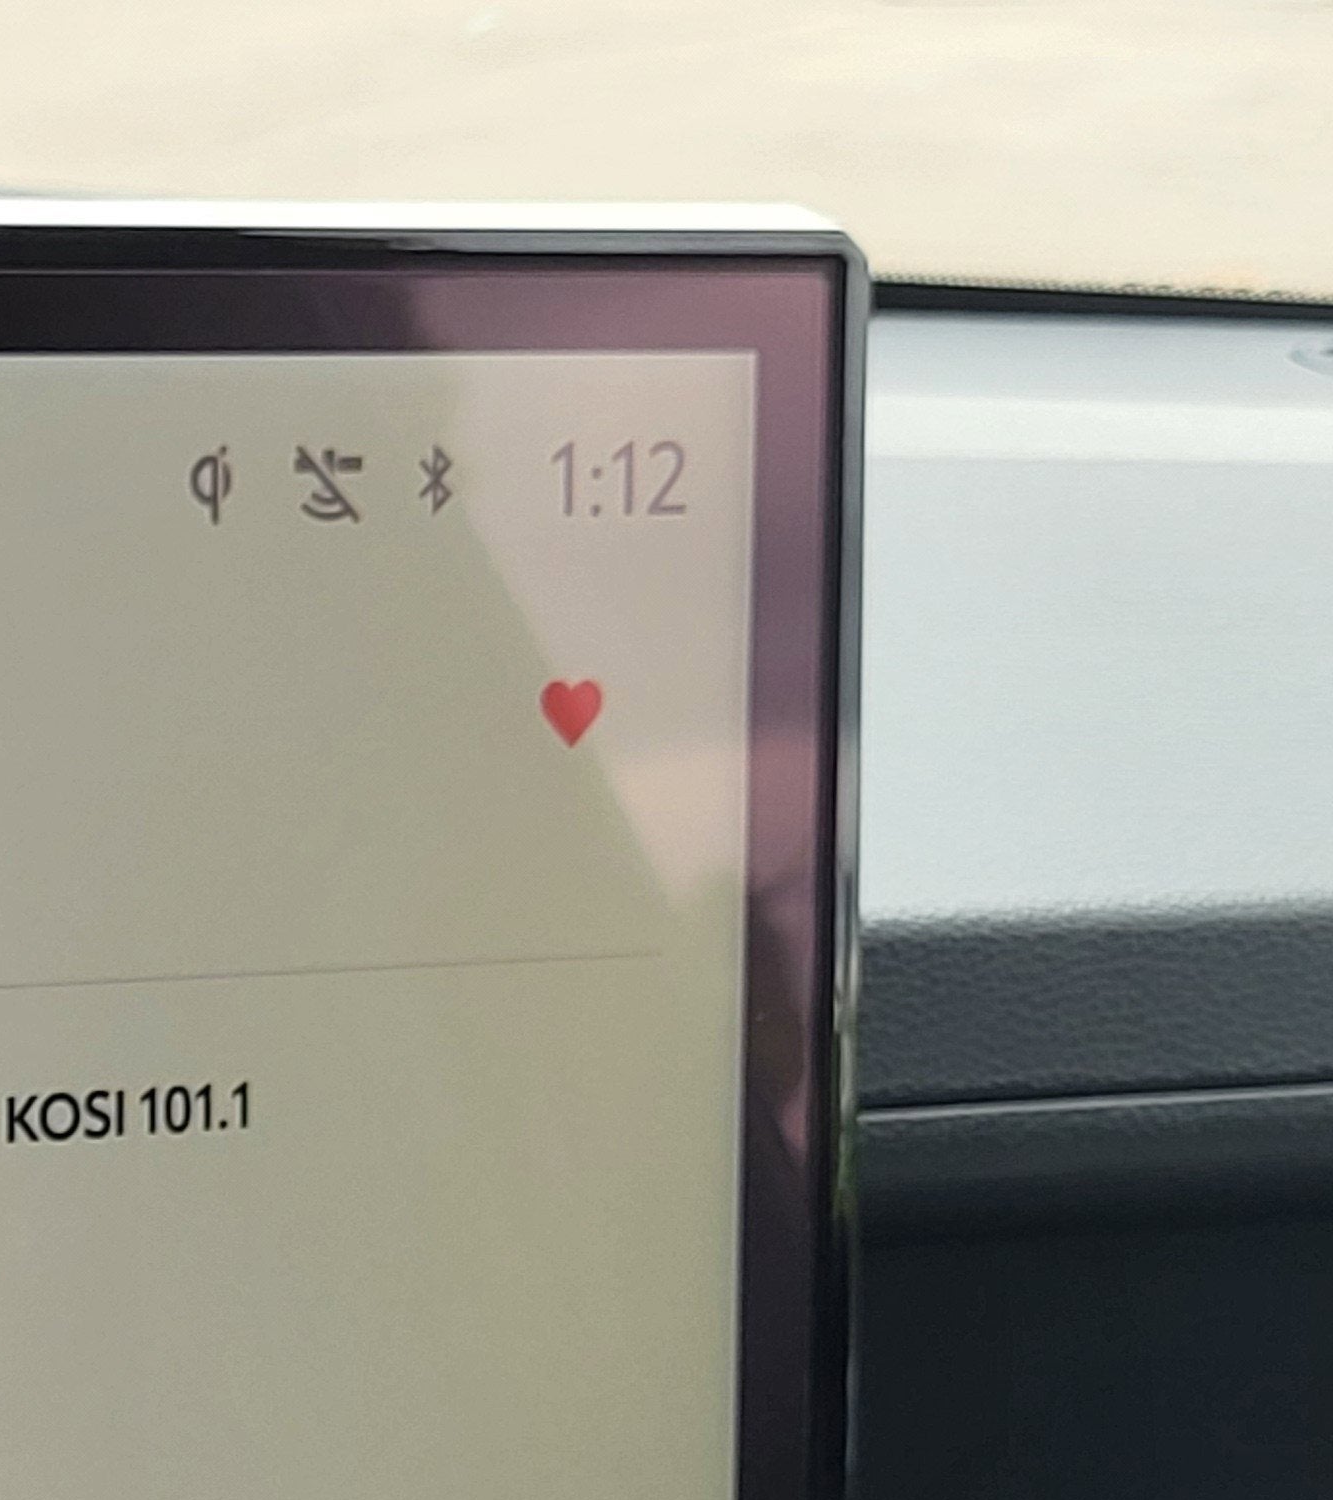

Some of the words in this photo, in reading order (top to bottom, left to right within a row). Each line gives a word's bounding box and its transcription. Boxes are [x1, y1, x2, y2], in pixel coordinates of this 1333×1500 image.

[551, 440, 687, 517] 1:12
[5, 1090, 124, 1144] KOSI
[141, 1082, 251, 1134] 101.1
